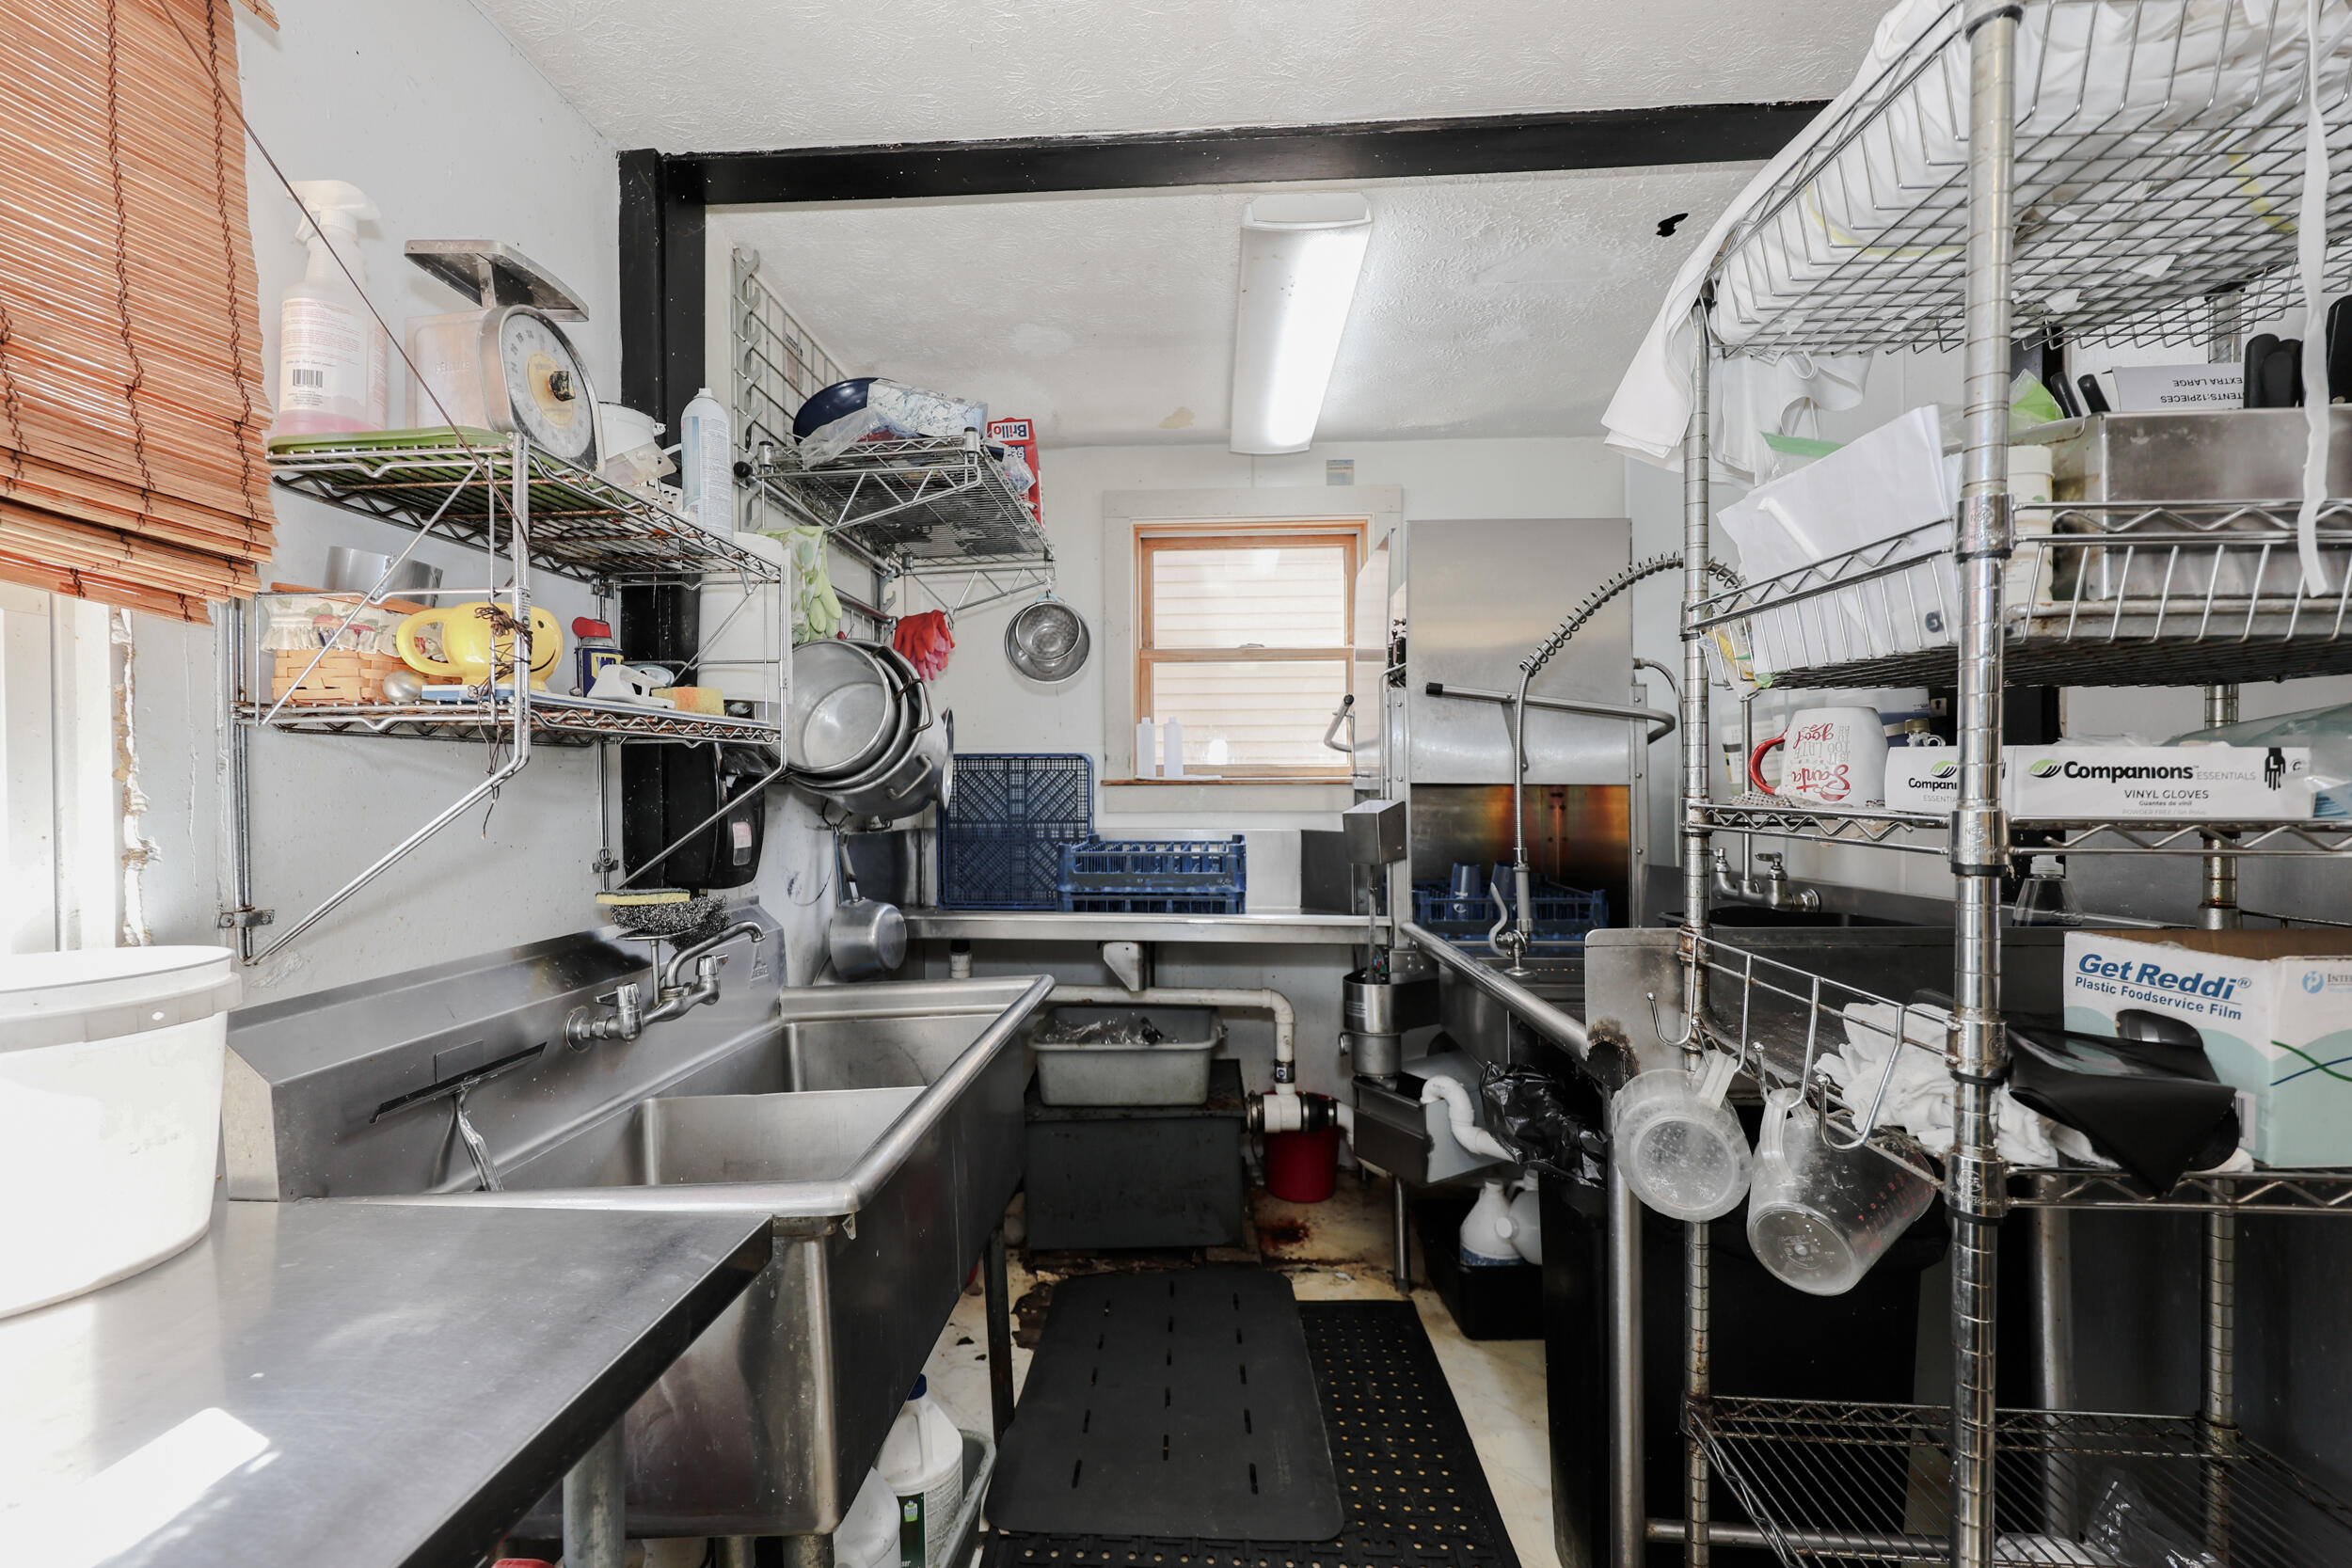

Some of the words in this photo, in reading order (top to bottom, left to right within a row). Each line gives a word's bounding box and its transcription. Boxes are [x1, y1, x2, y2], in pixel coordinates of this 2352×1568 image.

[2172, 378, 2208, 388] LARGE
[2210, 377, 2243, 386] EXTRA
[2160, 392, 2244, 404] TENTS:12PIECES
[993, 423, 1027, 439] Brillo
[1792, 764, 1851, 793] Santa
[2063, 760, 2194, 784] Companions
[2196, 770, 2257, 782] ESSENTIALS
[1908, 777, 1957, 792] Compani
[1923, 794, 1957, 802] ESSENTIA
[2123, 789, 2160, 800] VINYL
[2162, 789, 2210, 800] GLOVES
[2078, 953, 2133, 980] Get
[2327, 973, 2352, 983] INTE
[2074, 976, 2117, 995] Plastic
[2121, 985, 2204, 1013] Foodservice
[2209, 1003, 2242, 1021] Film
